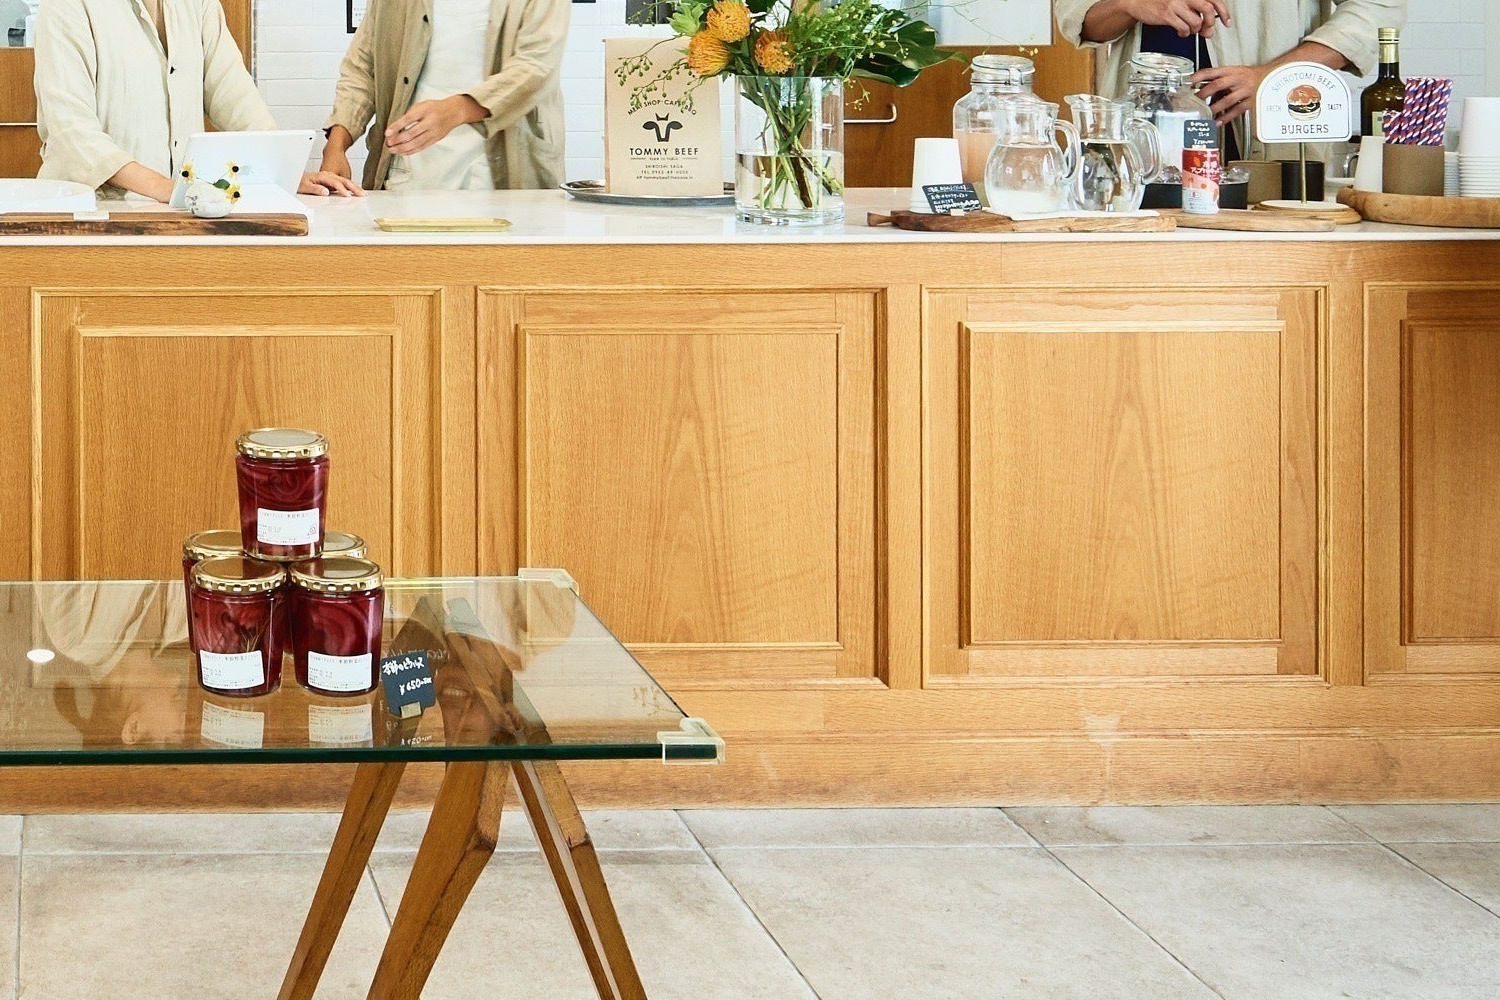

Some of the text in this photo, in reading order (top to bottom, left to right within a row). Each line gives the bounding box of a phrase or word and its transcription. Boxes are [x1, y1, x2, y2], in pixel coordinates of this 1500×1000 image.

[1317, 75, 1336, 90] BEEF
[644, 100, 661, 108] SHOP
[1281, 124, 1329, 134] BURGERS
[629, 148, 699, 156] TOMMY BEEF
